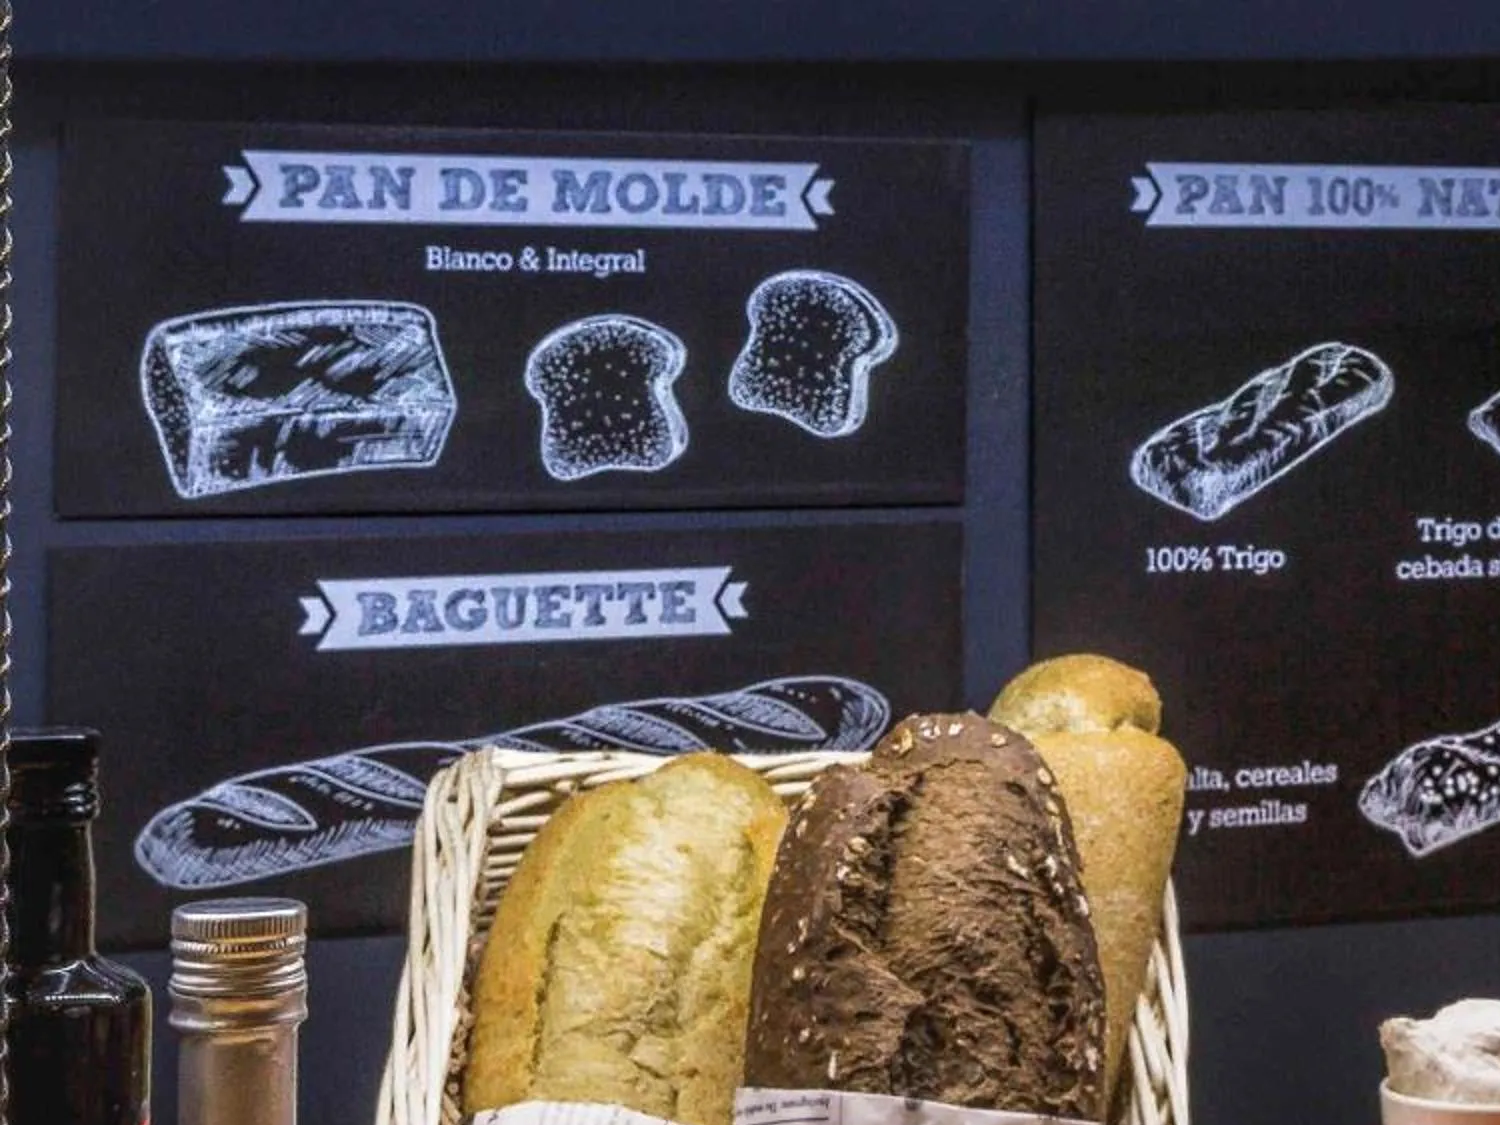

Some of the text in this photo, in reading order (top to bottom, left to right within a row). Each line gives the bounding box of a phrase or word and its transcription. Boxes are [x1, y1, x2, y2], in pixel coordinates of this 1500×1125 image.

[278, 162, 788, 218] PAN DE MOLDE
[1174, 173, 1290, 216] PAN
[1306, 175, 1400, 217] 100%
[425, 245, 646, 277] Blanco & Integral
[1417, 516, 1482, 547] Trigo
[1146, 544, 1286, 576] 100% Trigo
[1395, 556, 1484, 580] cebada
[355, 580, 697, 638] BAGUETTE
[1235, 760, 1339, 788] cereales
[1186, 799, 1308, 837] y semillas
